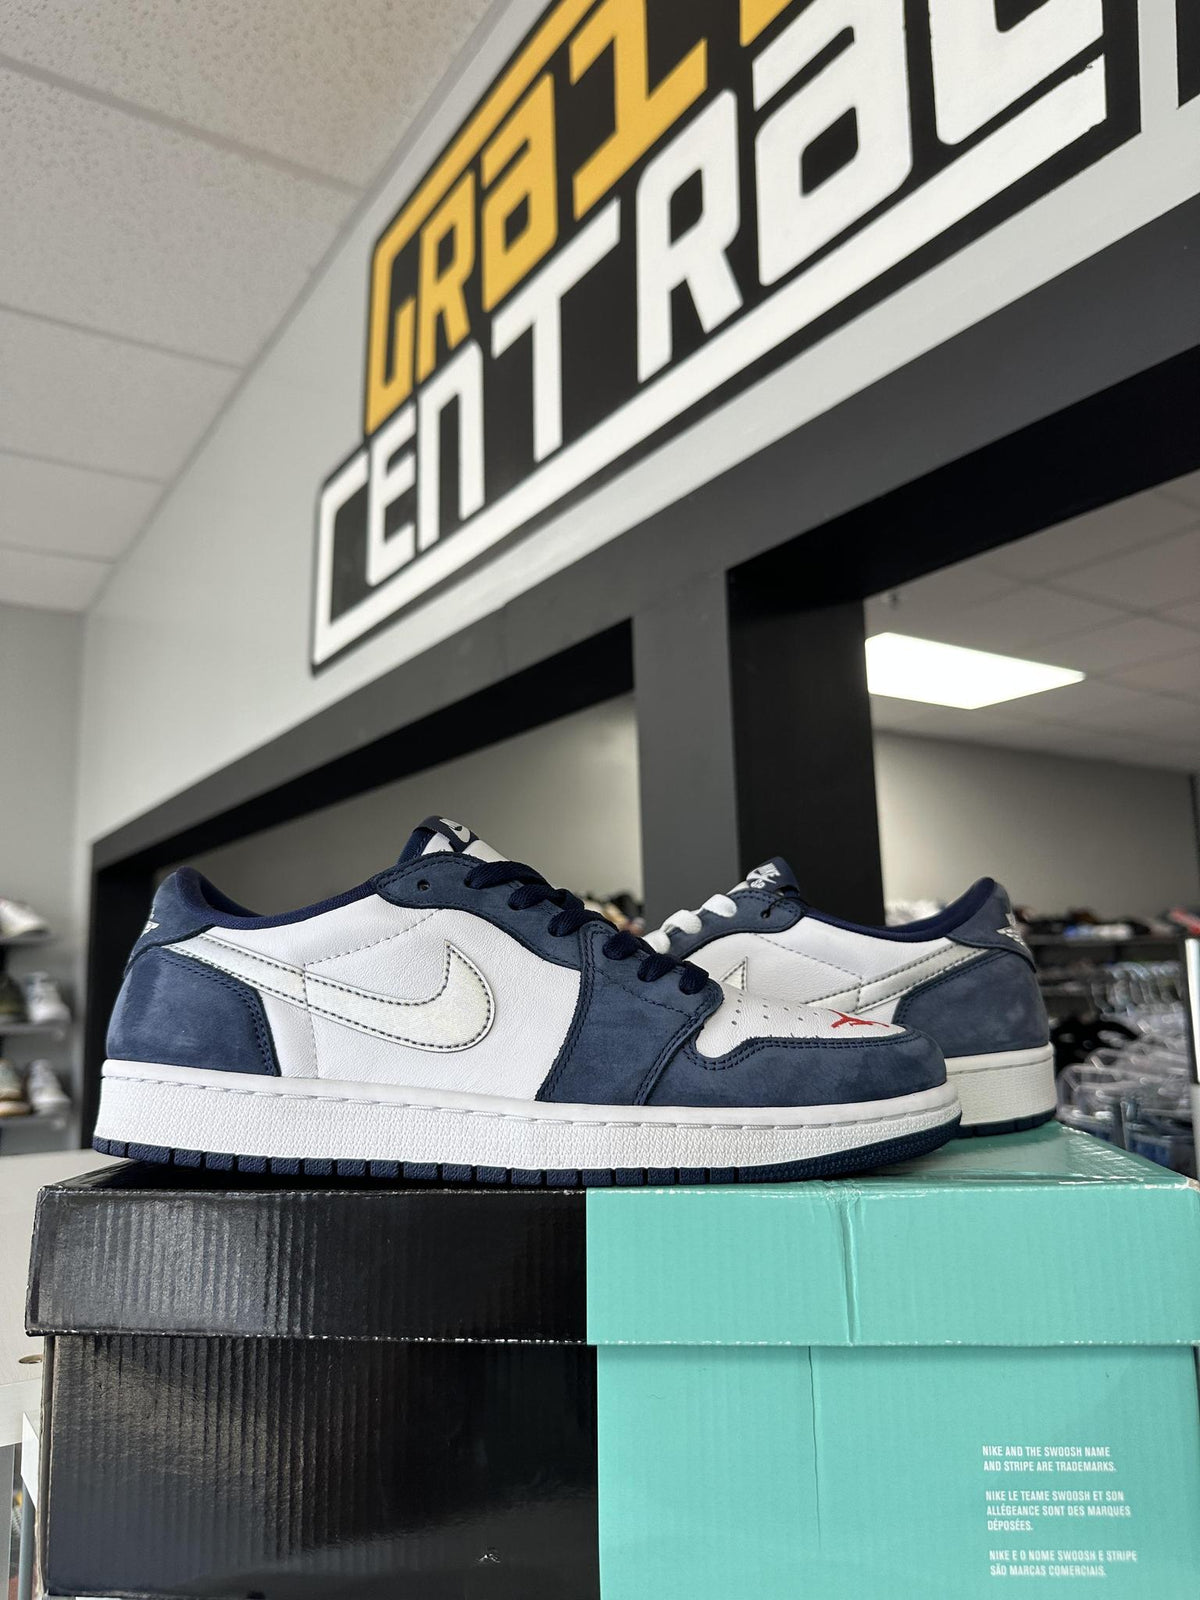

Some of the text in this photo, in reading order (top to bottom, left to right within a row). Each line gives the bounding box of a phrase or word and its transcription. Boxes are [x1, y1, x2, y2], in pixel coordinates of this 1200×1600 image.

[983, 1446, 1110, 1457] NIKE AND THE SWOOSH NAME
[984, 1461, 1116, 1472] AND STRIPE ARE TRADEMARKS.
[986, 1491, 1006, 1501] NIKE
[1008, 1491, 1018, 1501] LE
[1052, 1491, 1090, 1501] SWOOSH
[1093, 1491, 1103, 1501] ET
[1106, 1491, 1124, 1501] SON
[987, 1503, 1131, 1517] ALLÉGEANCE SONT DES MARQUES
[988, 1518, 1033, 1531] DÉPOSÉES.
[990, 1550, 1137, 1562] NIKE E O NOME SWOOSH E STRIPE
[990, 1564, 1106, 1576] SÃO MARCAS COMERCIAIS.
